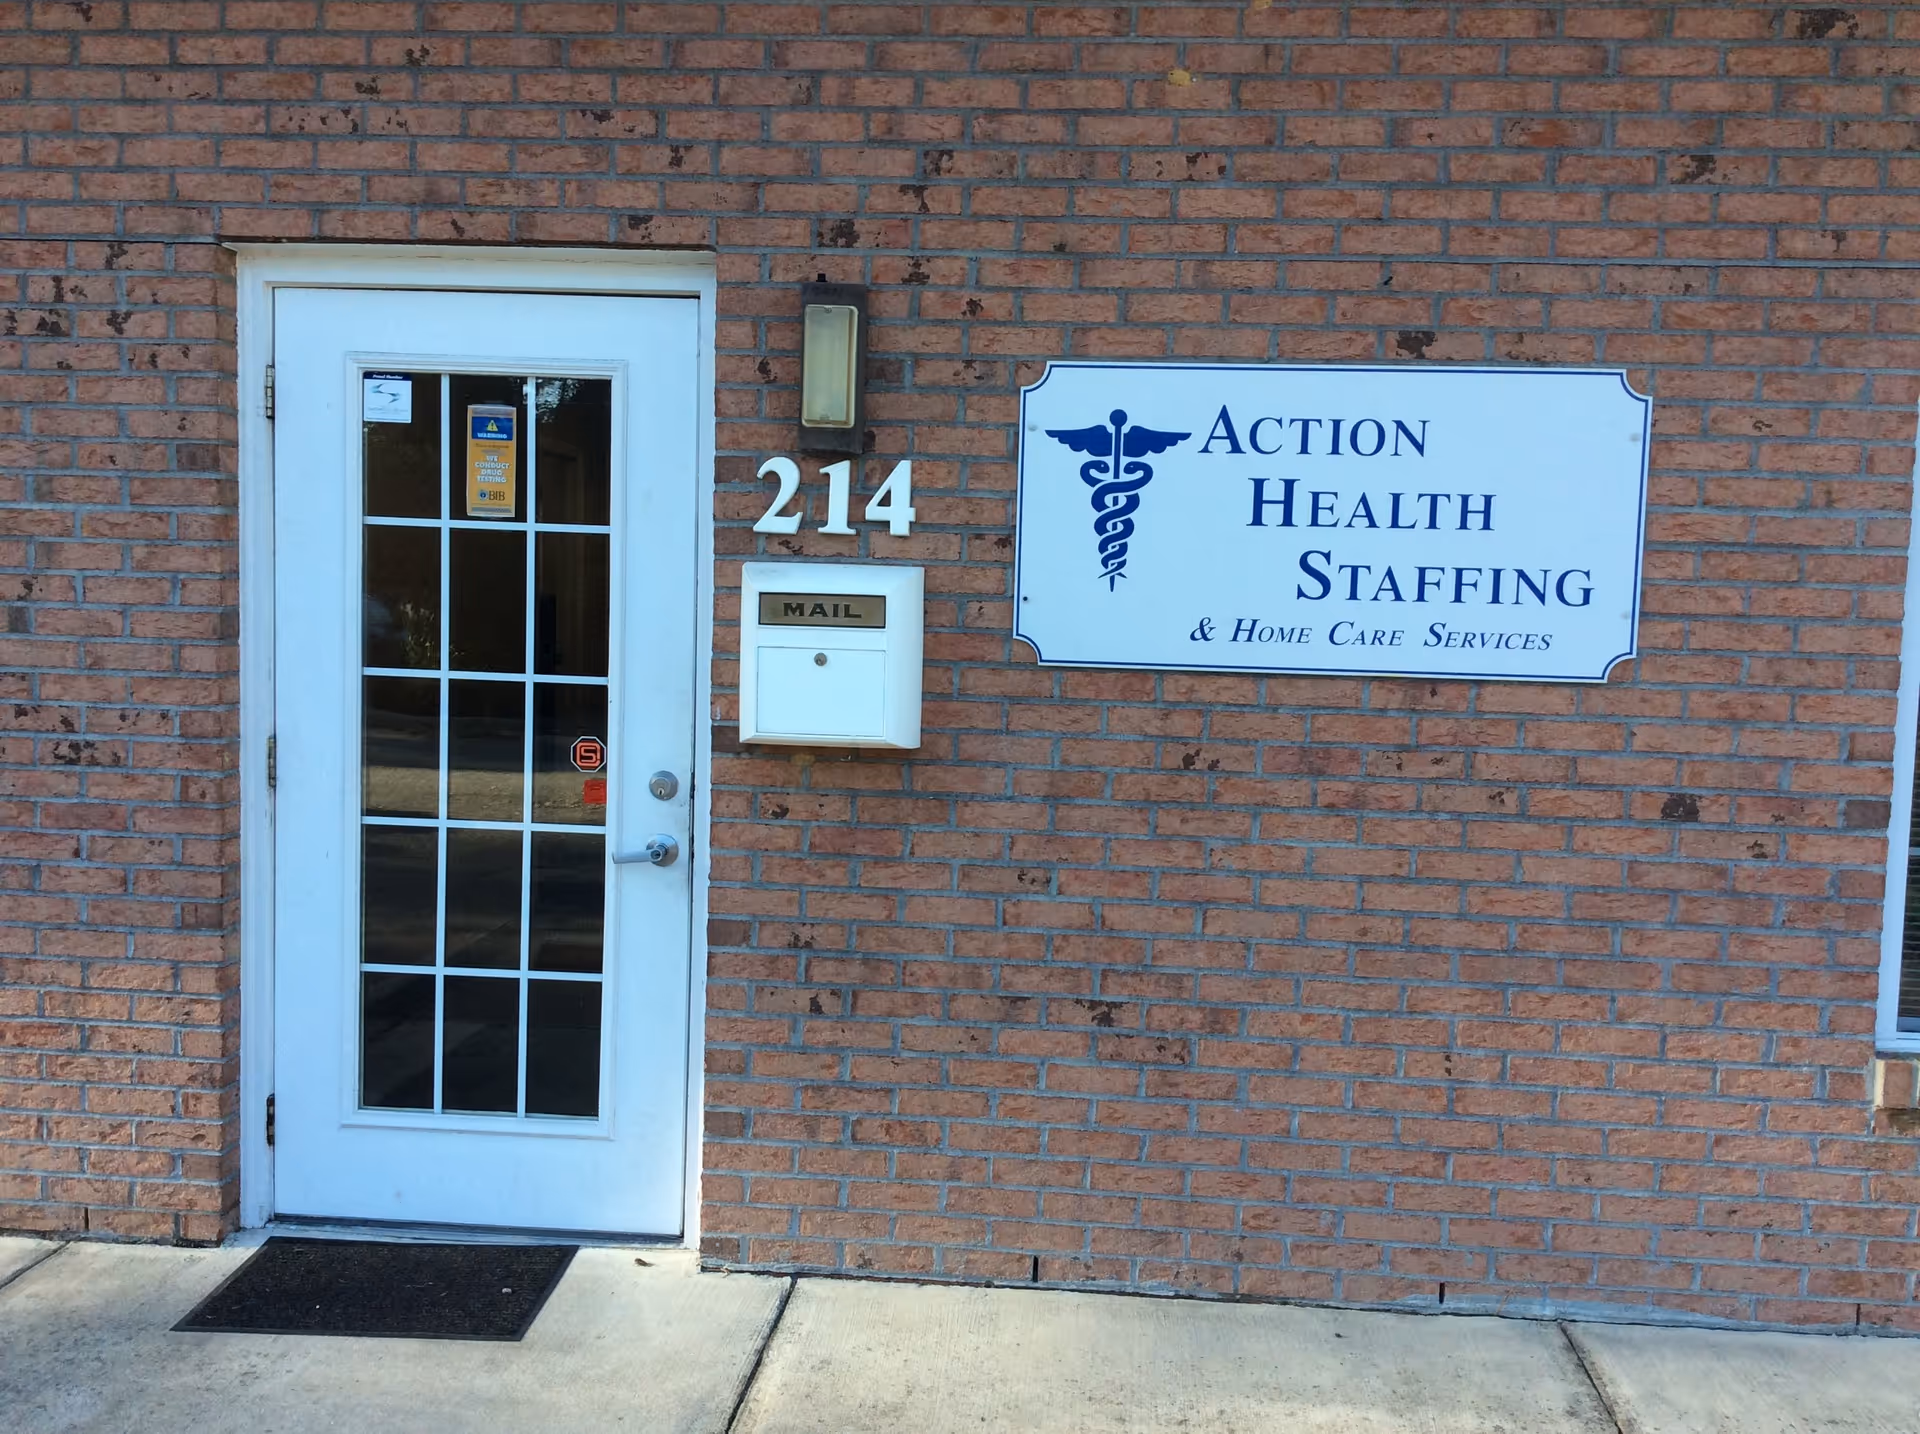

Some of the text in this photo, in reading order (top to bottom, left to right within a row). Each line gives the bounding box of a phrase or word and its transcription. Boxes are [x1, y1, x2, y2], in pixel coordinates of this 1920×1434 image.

[1198, 405, 1430, 457] ACTION
[474, 461, 510, 469] CONDUCT
[481, 468, 503, 476] DRUG
[477, 475, 507, 483] TESTING
[488, 490, 506, 501] BIB
[753, 456, 916, 537] 214
[1246, 478, 1496, 530] HEALTH
[1297, 550, 1594, 607] STAFFING
[783, 602, 862, 619] MAIL
[1190, 617, 1552, 650] & HOME CARE SERVICES
